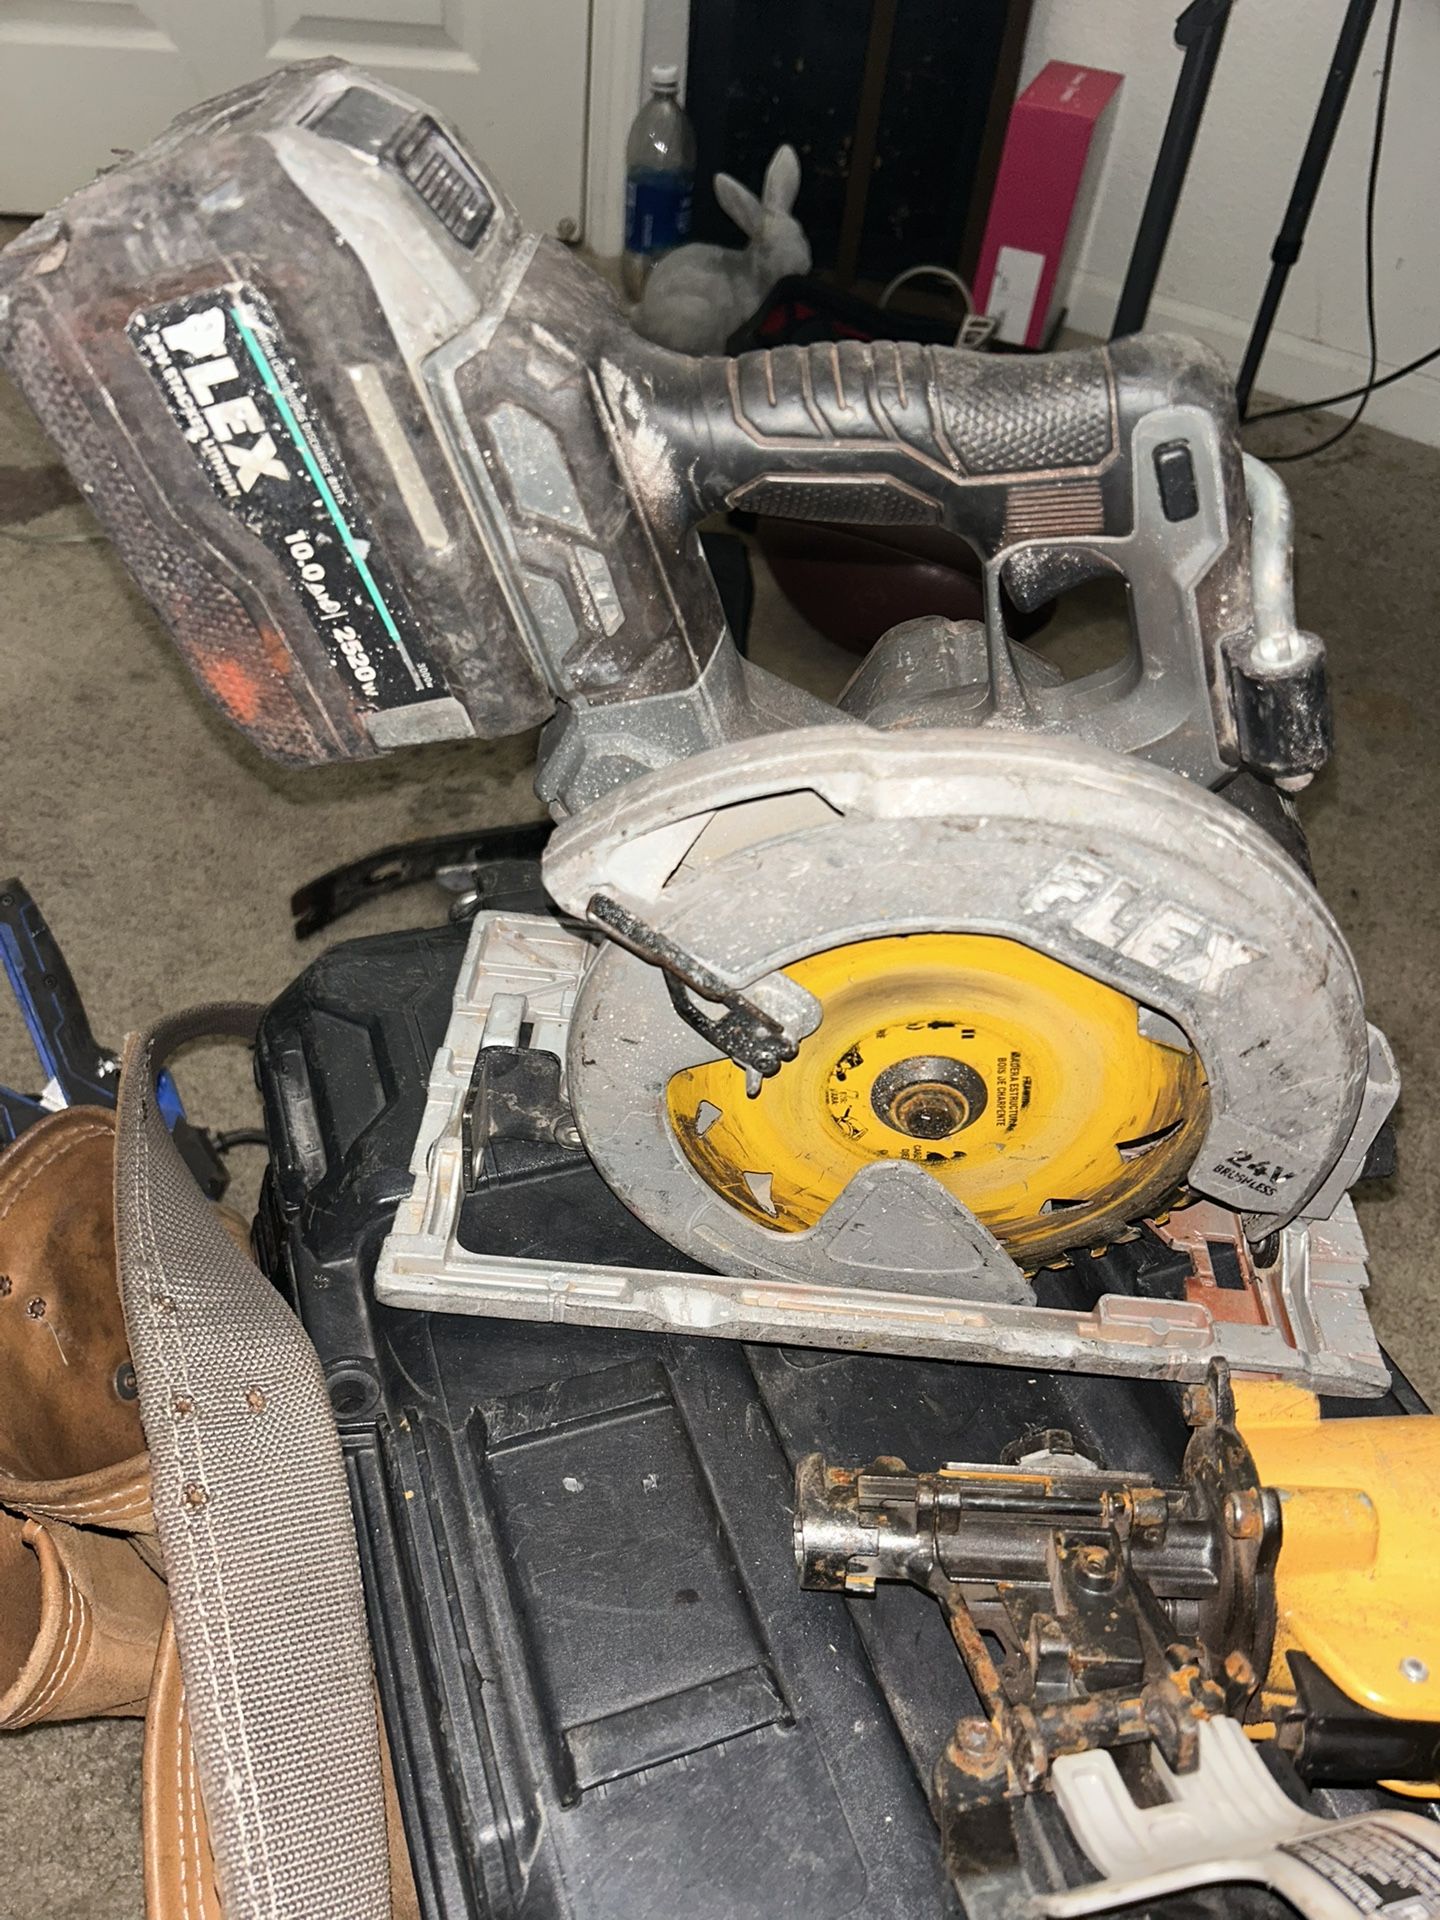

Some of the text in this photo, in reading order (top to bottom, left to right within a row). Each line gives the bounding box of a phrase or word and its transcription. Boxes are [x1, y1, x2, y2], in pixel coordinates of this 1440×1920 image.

[163, 365, 210, 441] STACKED
[301, 422, 334, 476] DISCHARGE
[326, 474, 348, 505] WATTS
[1021, 853, 1269, 994] FLEX
[997, 1057, 1006, 1074] BOIS
[996, 1086, 1006, 1127] CHARPENTE
[1211, 1163, 1278, 1197] BRUSHLESS
[1224, 1148, 1297, 1186] 24V
